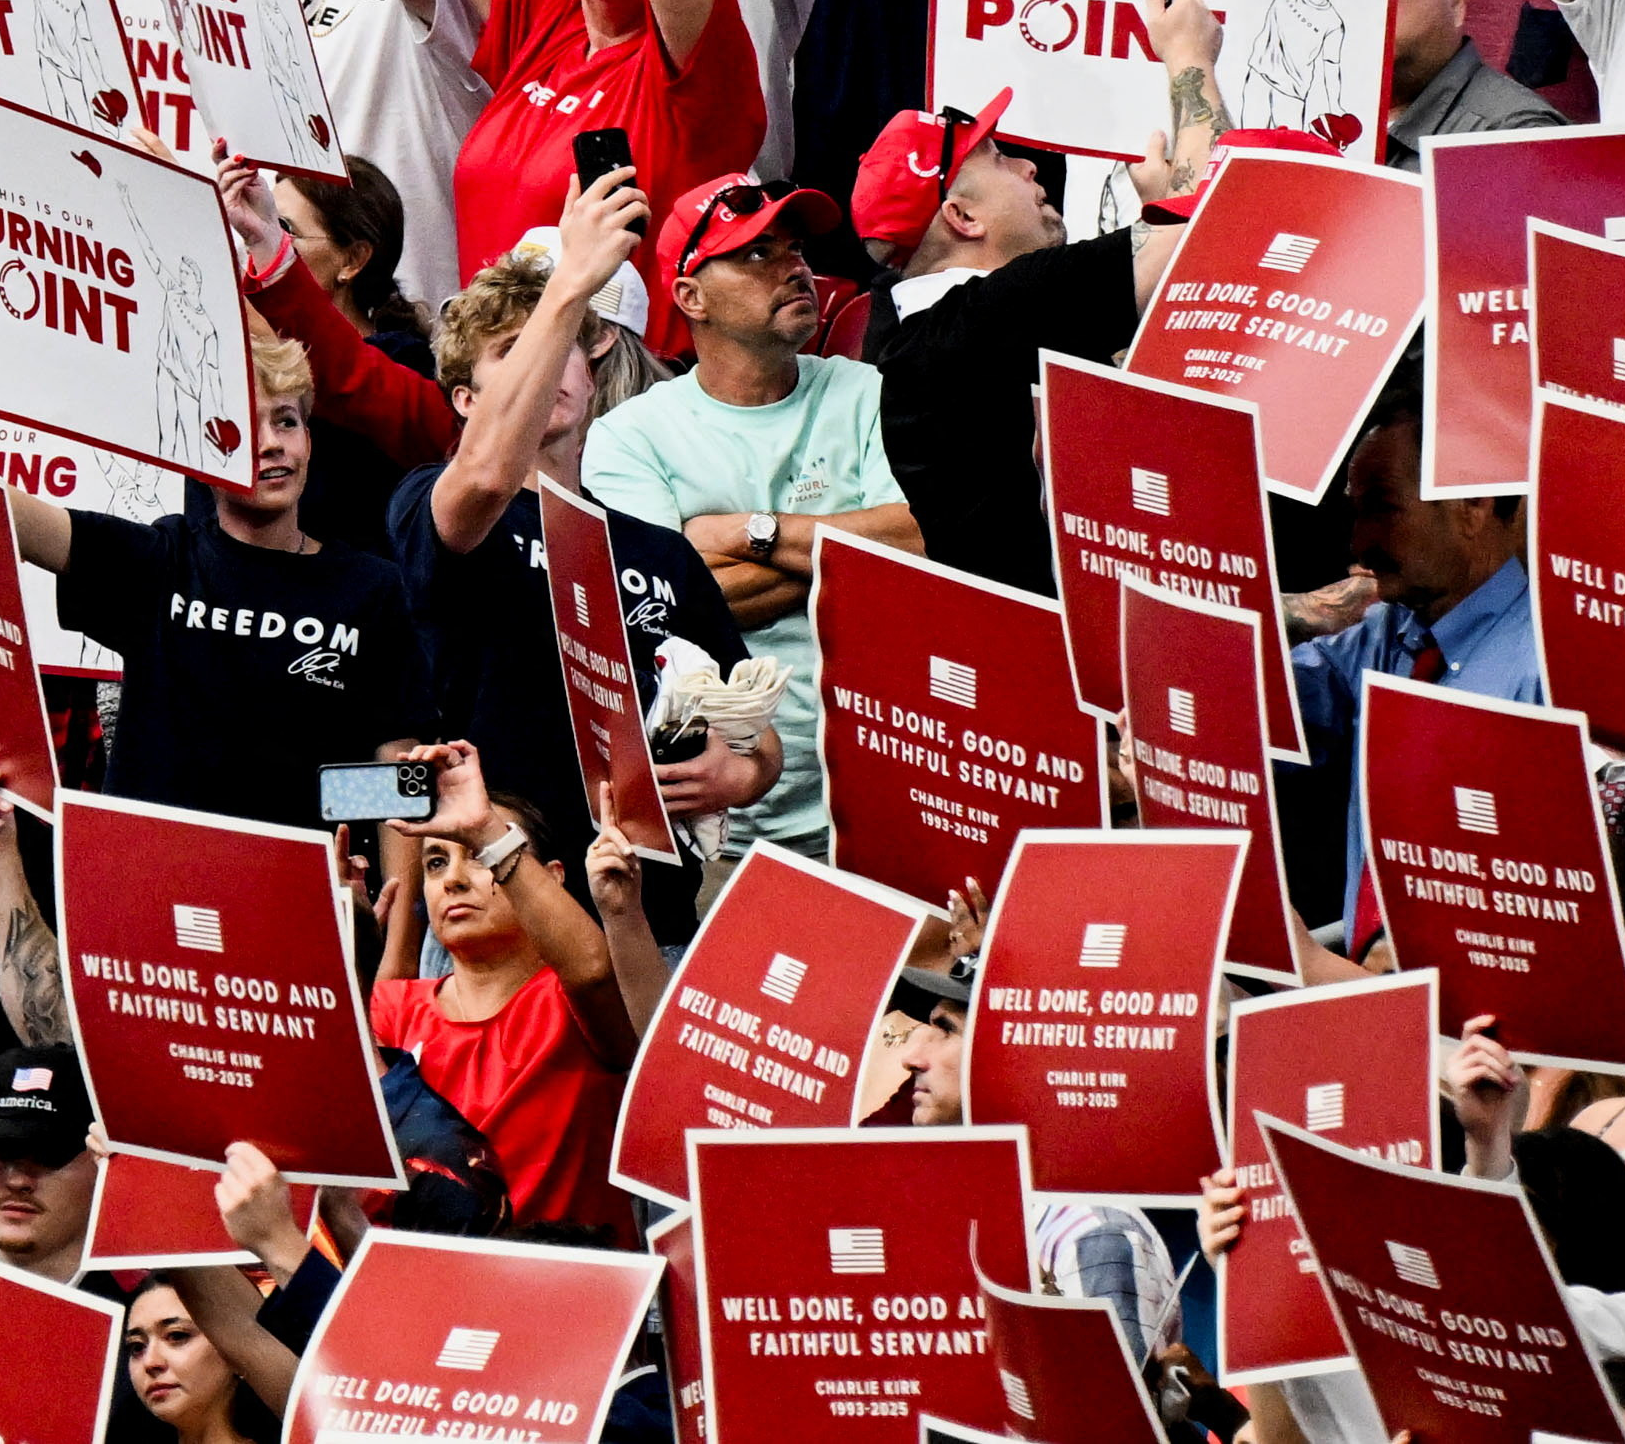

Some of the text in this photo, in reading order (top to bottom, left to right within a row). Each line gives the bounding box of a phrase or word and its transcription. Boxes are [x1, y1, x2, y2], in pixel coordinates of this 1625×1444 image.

[37, 201, 52, 216] IS
[62, 210, 94, 231] OUR
[1166, 283, 1388, 337] WELL DONE, GOOD AND
[1165, 311, 1349, 358] FAITHFUL SERVANT
[1184, 349, 1266, 371] CHARLIE KIRK
[169, 592, 361, 657] FREEDOM
[834, 686, 1084, 783] WELL DONE, GOOD AND
[857, 726, 1059, 808] FAITHFUL SERVANT
[910, 789, 1000, 828] CHARLIE KIRK
[81, 953, 337, 1010] WELL DONE, GOOD AND
[108, 990, 315, 1040] FAITHFUL SERVANT
[169, 1043, 262, 1070] CHARLIE KIRK
[0, 1096, 56, 1112] america.
